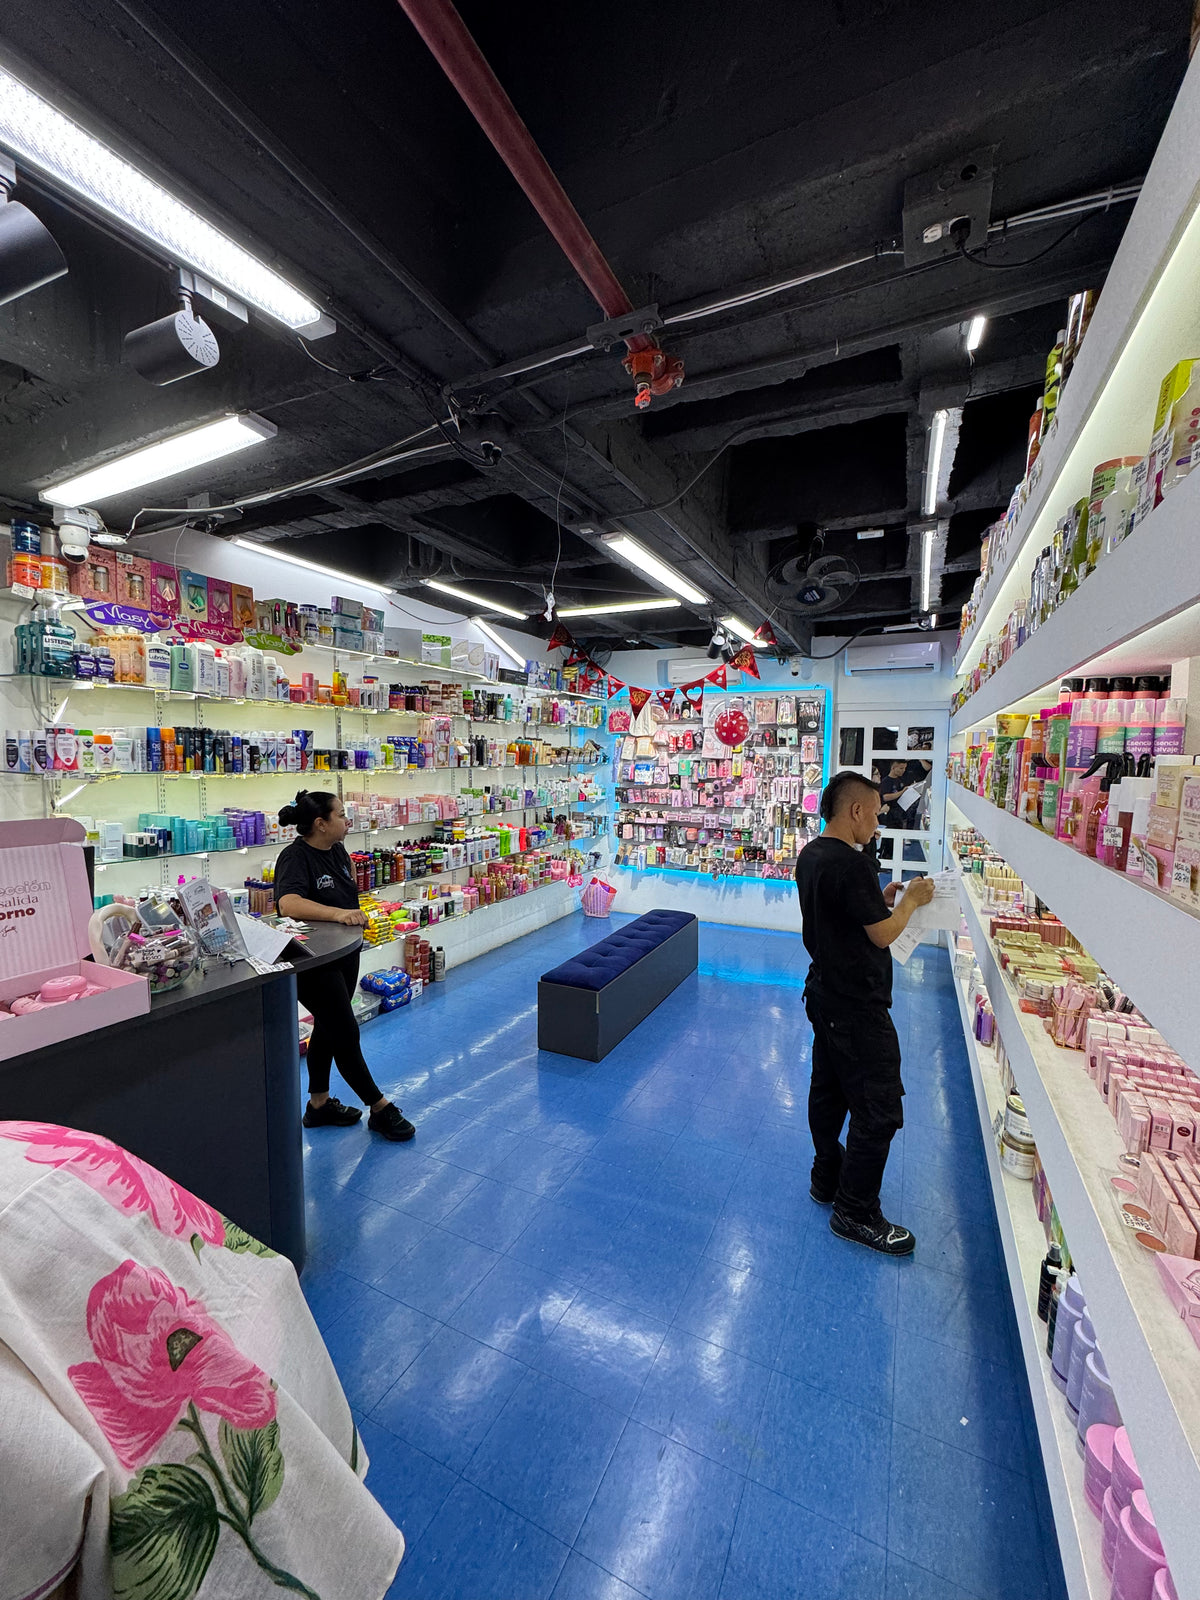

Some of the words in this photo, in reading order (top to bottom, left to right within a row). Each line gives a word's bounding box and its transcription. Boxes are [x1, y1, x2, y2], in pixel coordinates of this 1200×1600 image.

[104, 604, 151, 629] Vlasy
[188, 620, 227, 642] Vlasy
[44, 637, 73, 647] LISTERINE
[257, 633, 290, 653] Vlasy
[1126, 746, 1152, 754] Salvaje
